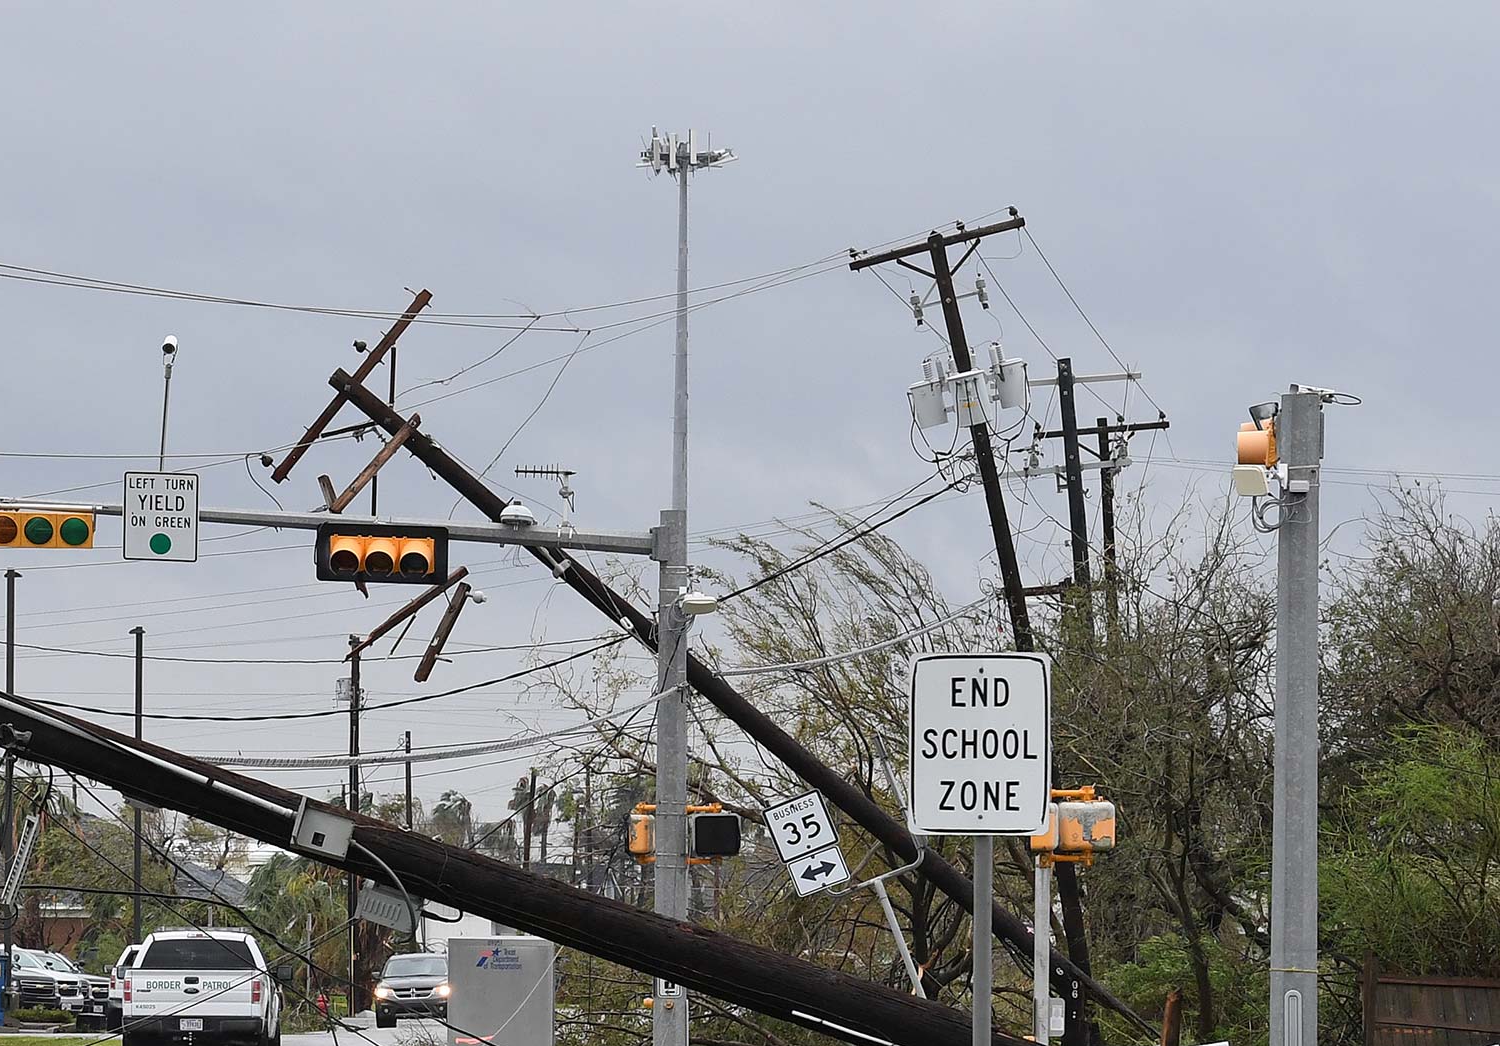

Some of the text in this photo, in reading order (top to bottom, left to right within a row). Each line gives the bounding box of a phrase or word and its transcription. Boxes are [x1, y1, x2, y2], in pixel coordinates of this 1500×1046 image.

[129, 478, 193, 490] LEFT TURN
[138, 495, 185, 511] YIELD
[131, 515, 191, 528] ON GREEN
[951, 677, 1010, 707] END
[922, 729, 1037, 759] SCHOOL
[939, 780, 1020, 811] ZONE
[773, 799, 815, 821] BUSINESS
[783, 813, 821, 845] 35
[146, 980, 181, 990] BORDER
